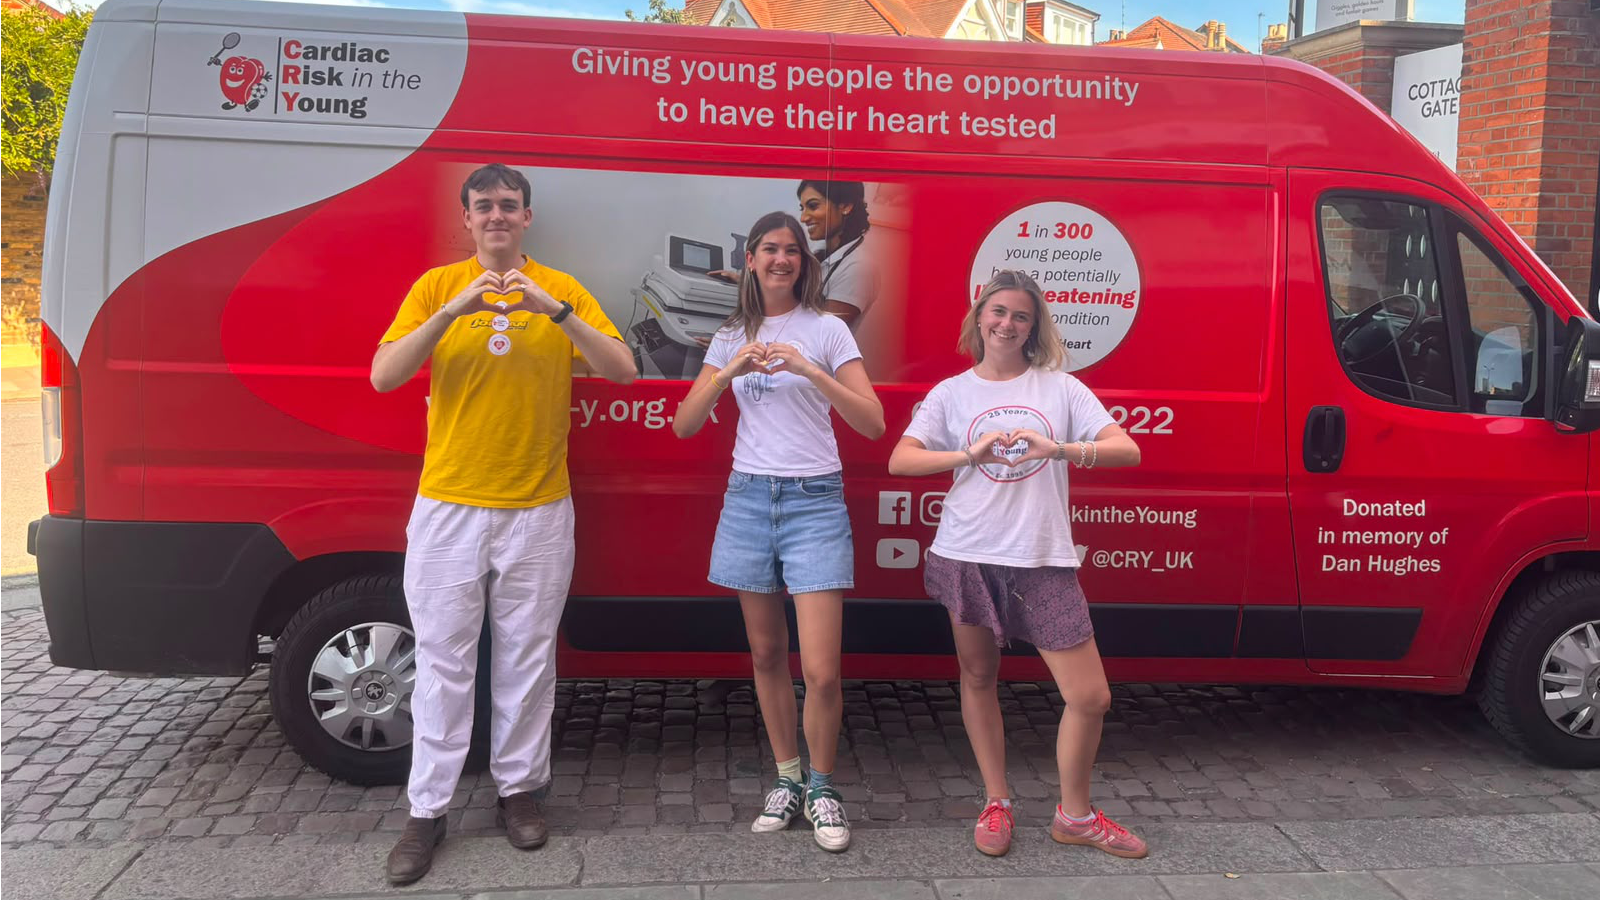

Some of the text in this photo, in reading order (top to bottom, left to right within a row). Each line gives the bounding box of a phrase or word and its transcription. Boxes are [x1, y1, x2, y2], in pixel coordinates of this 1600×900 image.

[283, 40, 390, 63] Cardiac
[282, 65, 421, 90] Risk in the
[570, 47, 1139, 106] Giving young people the opportunity
[282, 92, 368, 119] Young
[1421, 98, 1457, 118] GATE
[657, 97, 1056, 139] to have their heart tested
[1017, 221, 1093, 239] 1 in 300
[1005, 248, 1102, 263] young people
[1030, 270, 1039, 280] a
[1044, 269, 1121, 285] potentially
[1052, 313, 1110, 325] ondition
[1108, 405, 1174, 434] 222
[1000, 447, 1027, 455] Young
[1071, 505, 1198, 528] kintheYoung
[1343, 498, 1426, 516] Donated
[1318, 527, 1449, 548] in memory of
[1092, 550, 1194, 572] @CRY_UK
[1322, 554, 1441, 576] Dan Hughes
